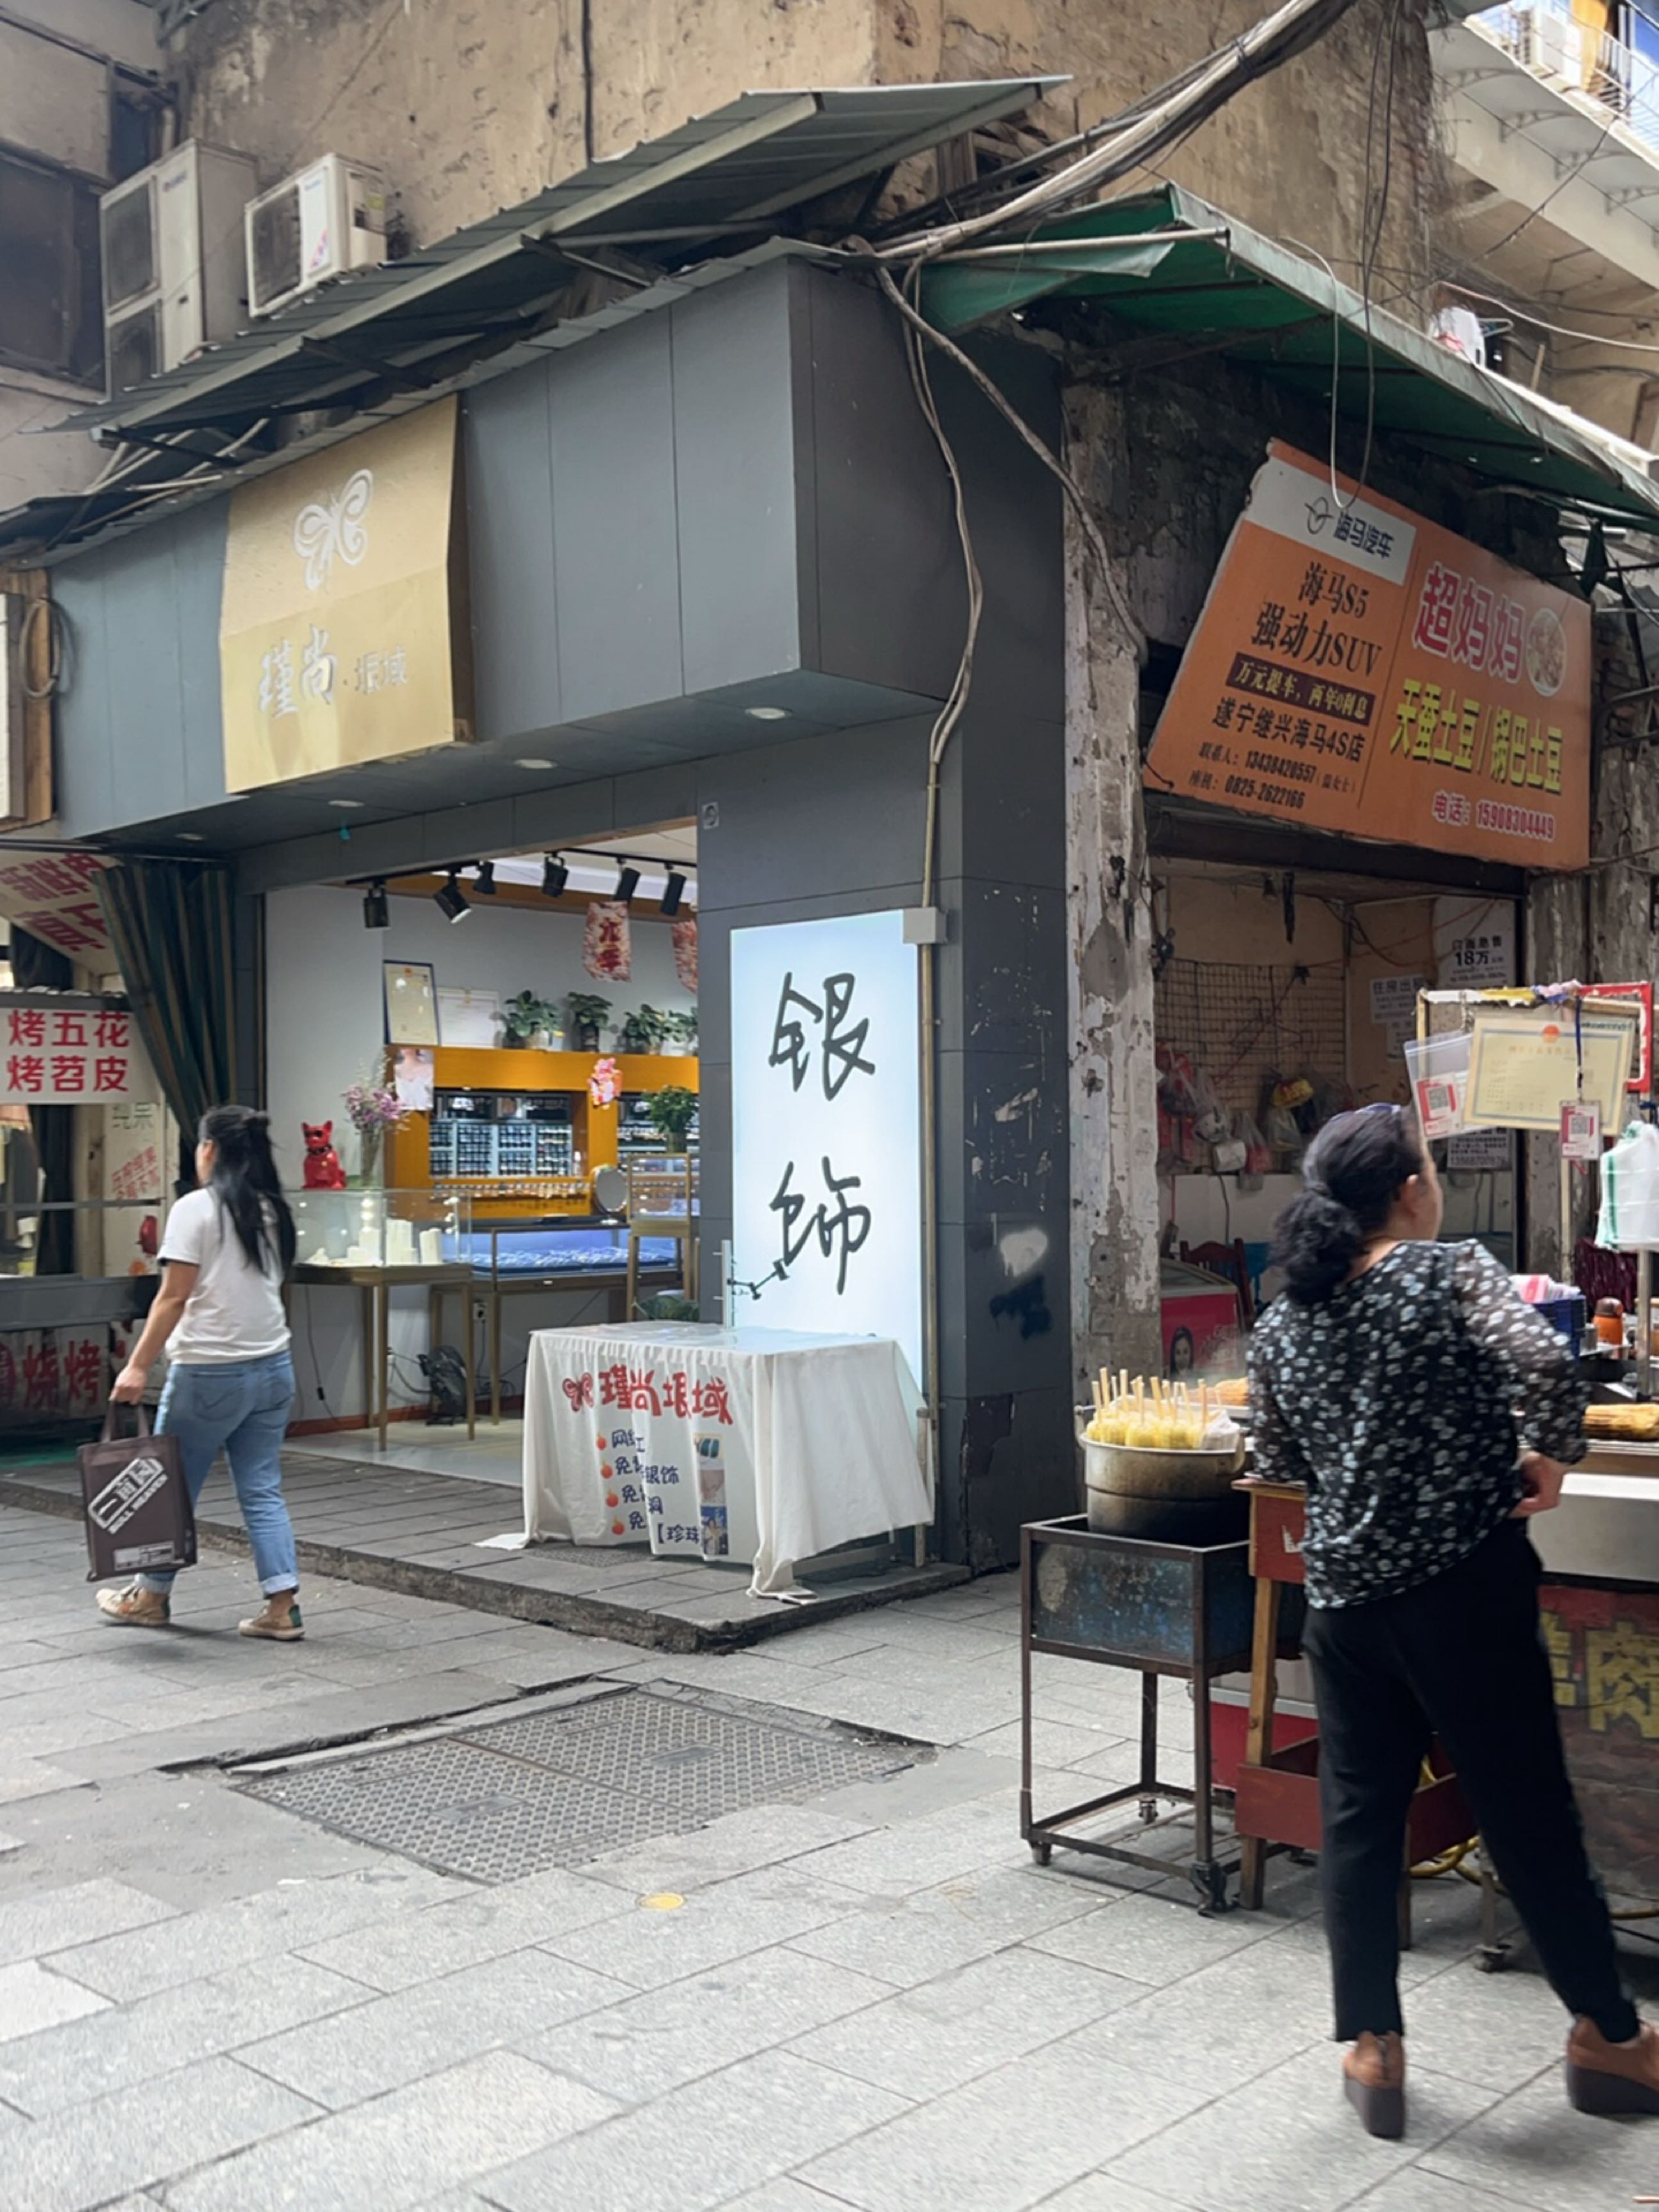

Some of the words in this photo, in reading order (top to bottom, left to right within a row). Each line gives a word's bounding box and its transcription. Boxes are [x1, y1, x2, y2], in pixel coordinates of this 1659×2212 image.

[1297, 561, 1369, 618] 海马S5
[1251, 600, 1382, 677] 强动力SUV
[1414, 562, 1525, 683] 超妈妈
[1212, 696, 1365, 762] 遂宁继兴海马4S店
[1455, 950, 1490, 966] 18万
[8, 1009, 129, 1048] 烤五花
[6, 1055, 129, 1093] 烤苕皮
[598, 1364, 733, 1425] 瑾尚垠域
